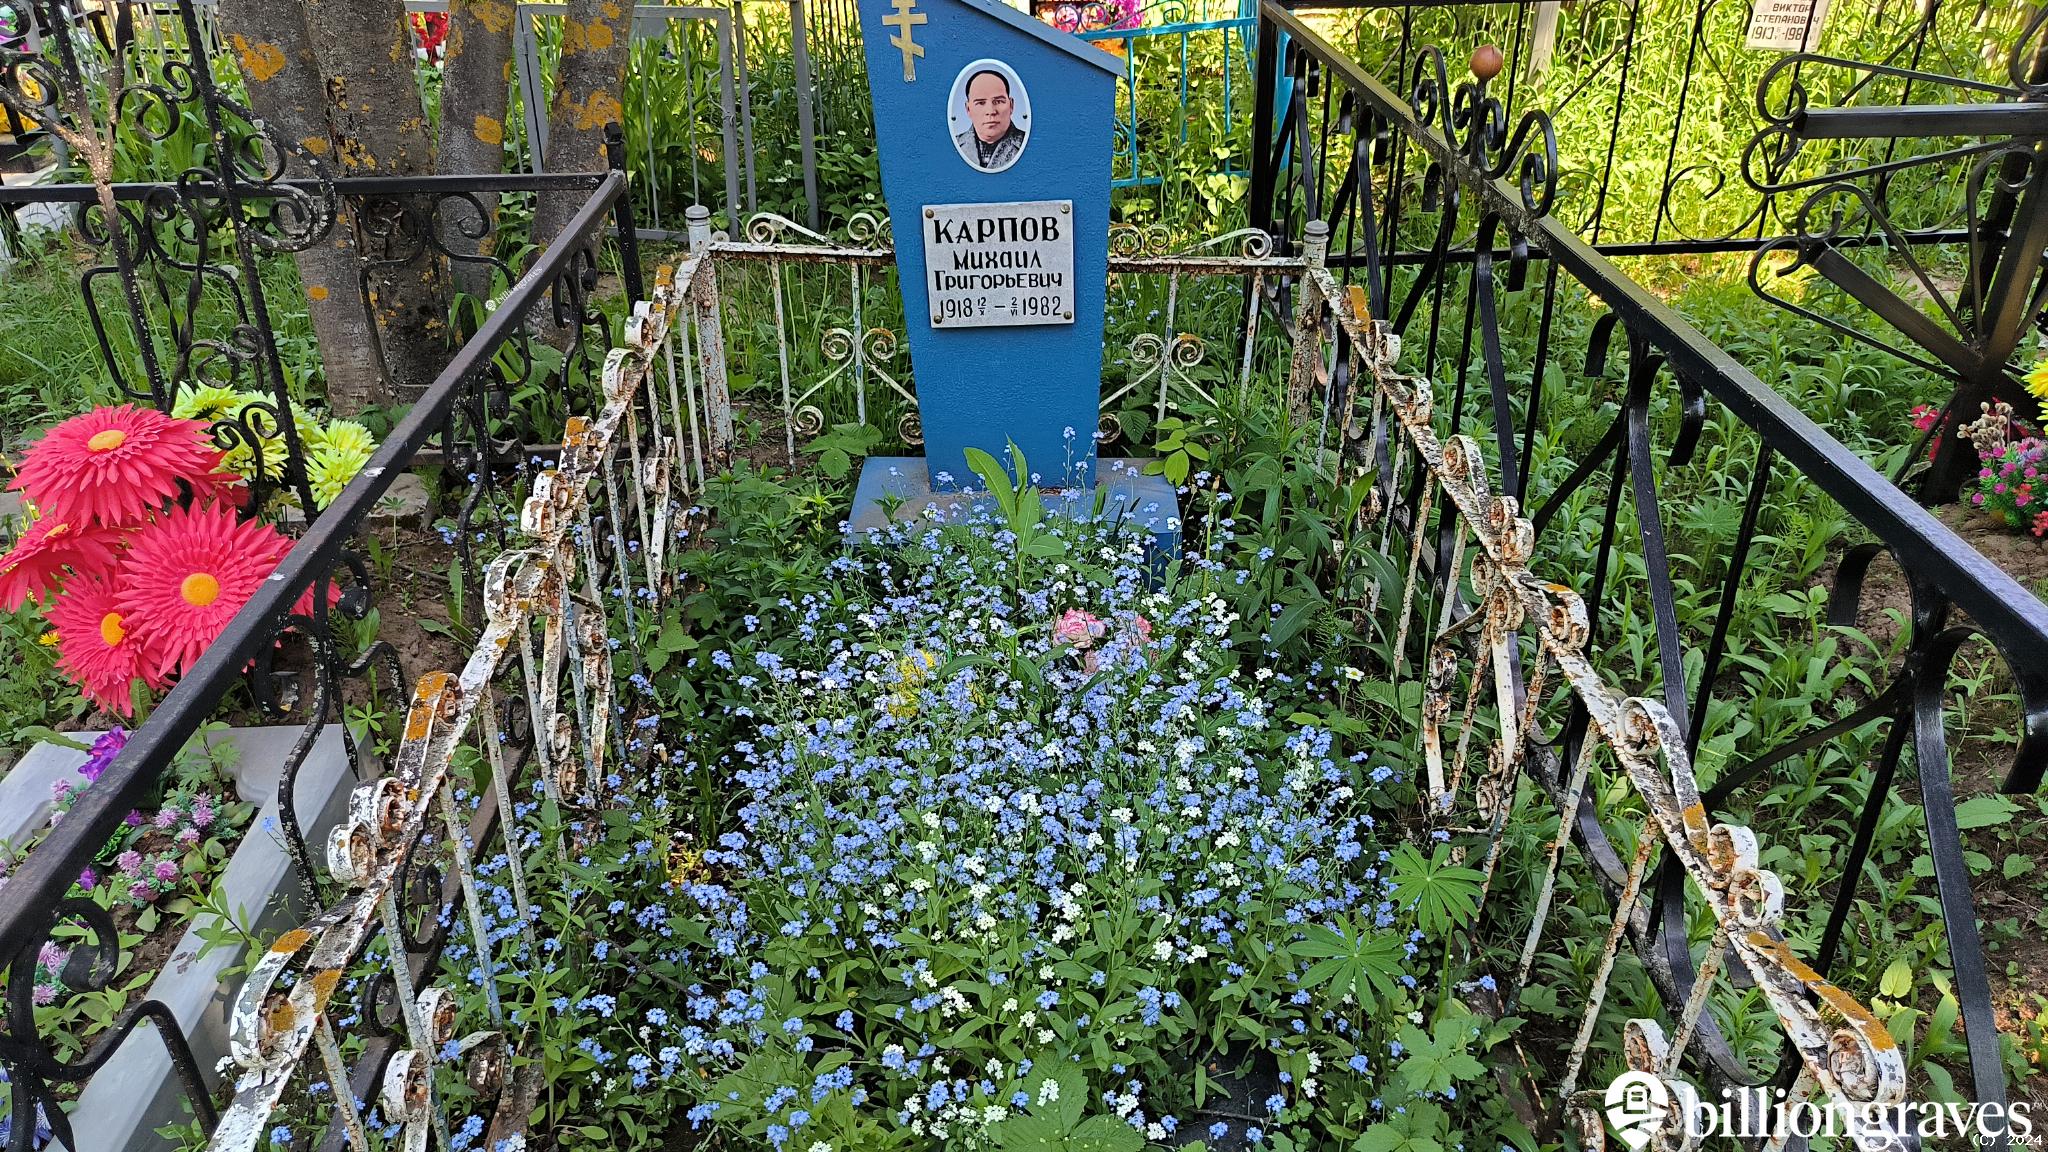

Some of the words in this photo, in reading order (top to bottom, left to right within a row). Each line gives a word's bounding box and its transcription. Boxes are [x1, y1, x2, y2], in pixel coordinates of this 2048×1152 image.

[1772, 3, 1811, 12] ВИКТОР
[1755, 15, 1820, 24] СТЕПАНОВЧ
[934, 216, 1060, 244] КАРПОВ
[939, 298, 973, 319] 1918
[1022, 296, 1062, 316] 1982
